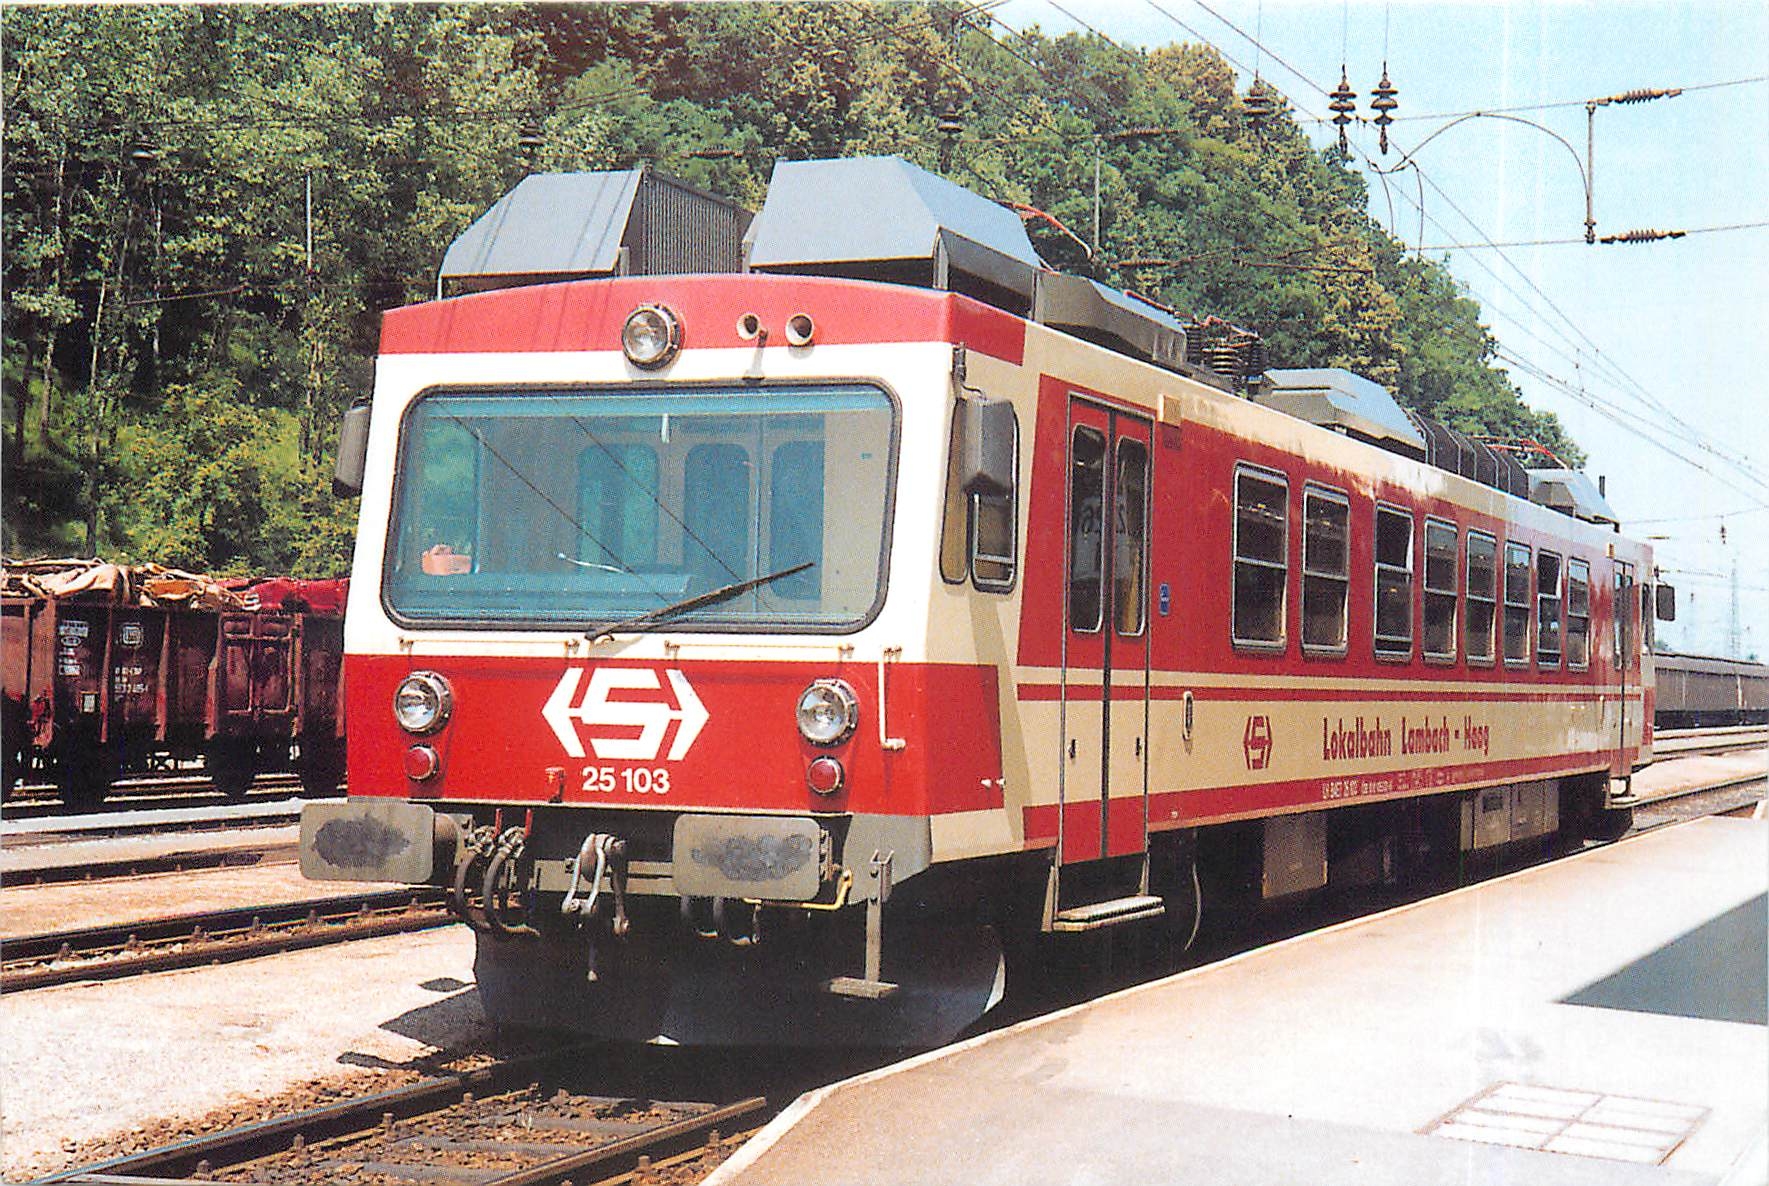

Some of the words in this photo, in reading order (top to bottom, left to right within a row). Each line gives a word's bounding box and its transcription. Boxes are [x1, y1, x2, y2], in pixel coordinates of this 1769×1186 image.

[1323, 716, 1392, 760] Lokalbahn
[1401, 716, 1450, 755] Lambach
[581, 766, 617, 793] 25
[620, 767, 671, 795] 103
